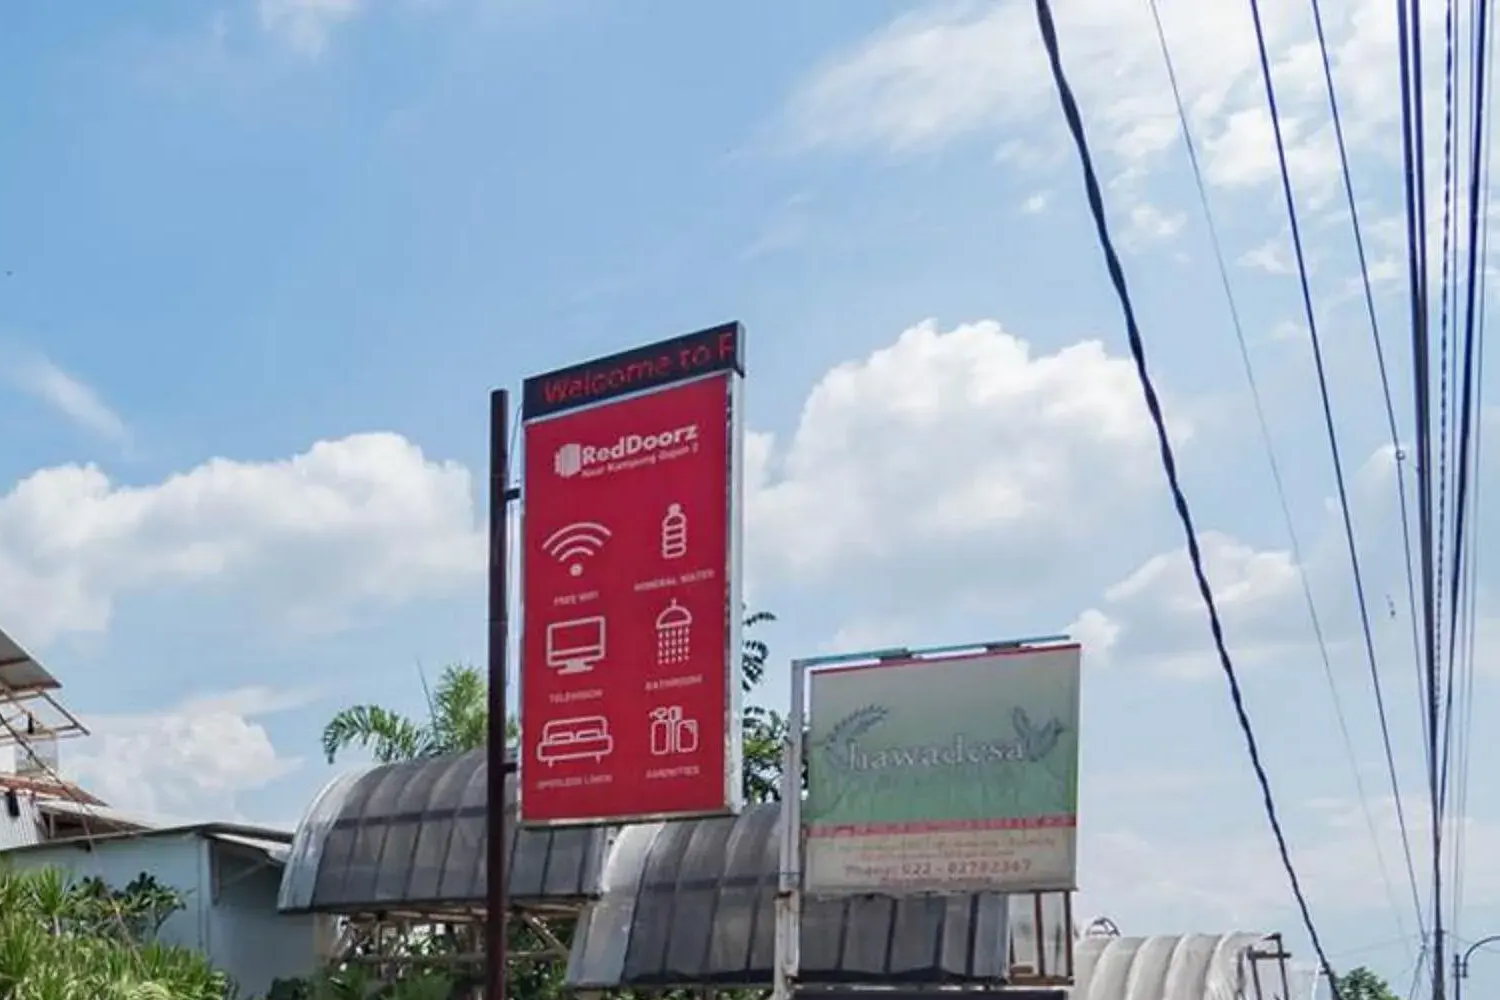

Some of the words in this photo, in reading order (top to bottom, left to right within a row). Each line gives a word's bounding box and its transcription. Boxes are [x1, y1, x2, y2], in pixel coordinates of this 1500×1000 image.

[543, 355, 672, 402] Welcome
[679, 343, 710, 370] to
[582, 424, 698, 465] RedDoorz
